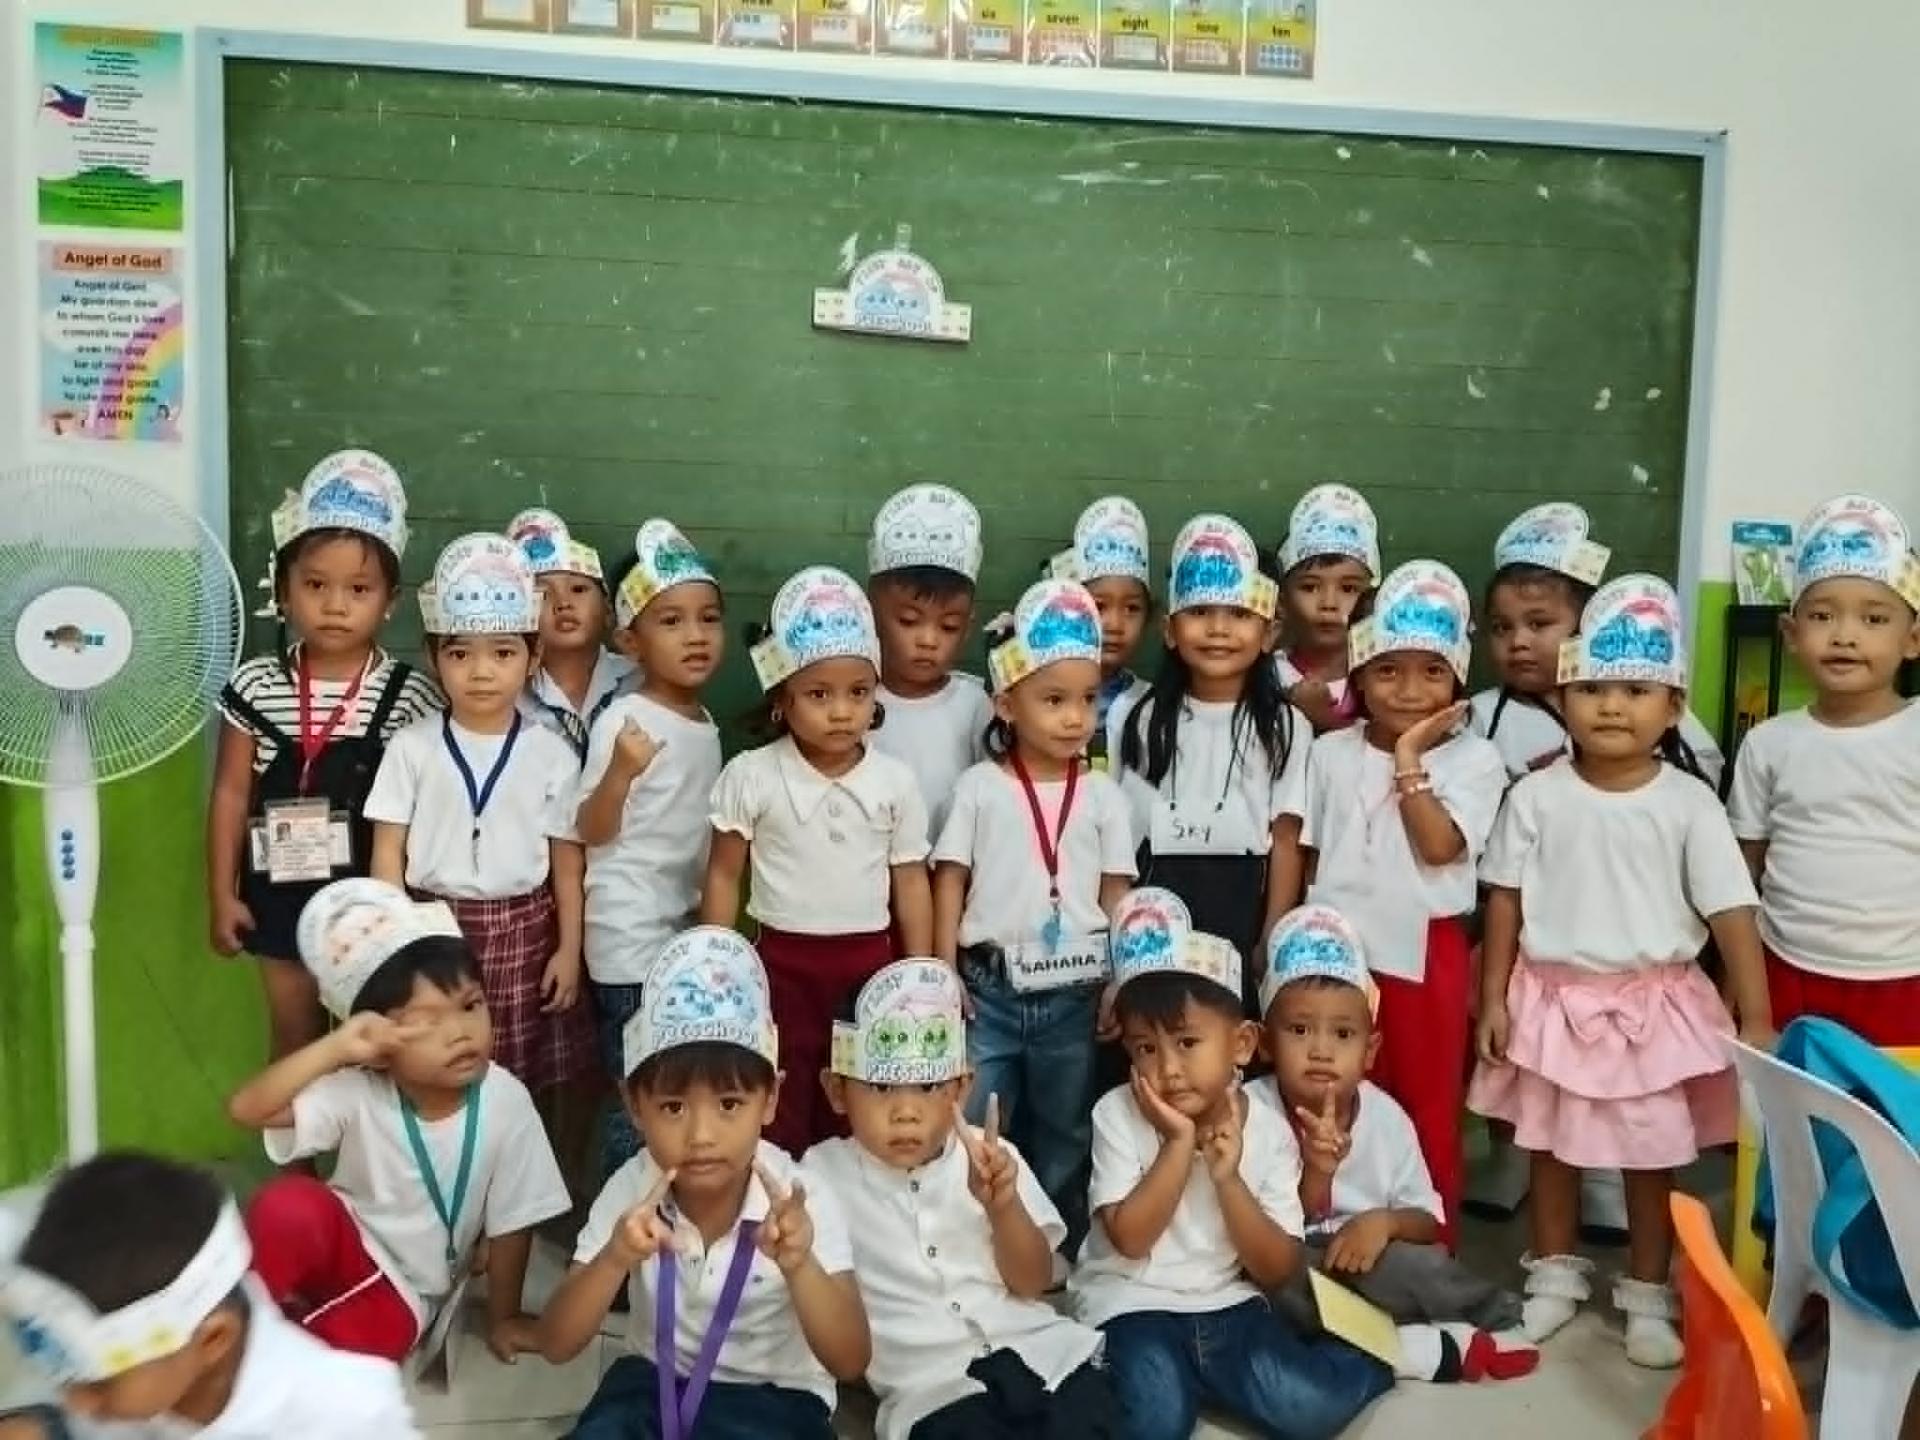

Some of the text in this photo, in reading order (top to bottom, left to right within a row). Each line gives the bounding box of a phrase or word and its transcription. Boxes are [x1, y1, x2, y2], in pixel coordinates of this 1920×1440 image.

[1047, 14, 1080, 25] seven
[1121, 15, 1149, 31] eight
[1272, 25, 1291, 38] ten
[65, 252, 162, 268] Angel of God
[98, 409, 133, 420] AMEN
